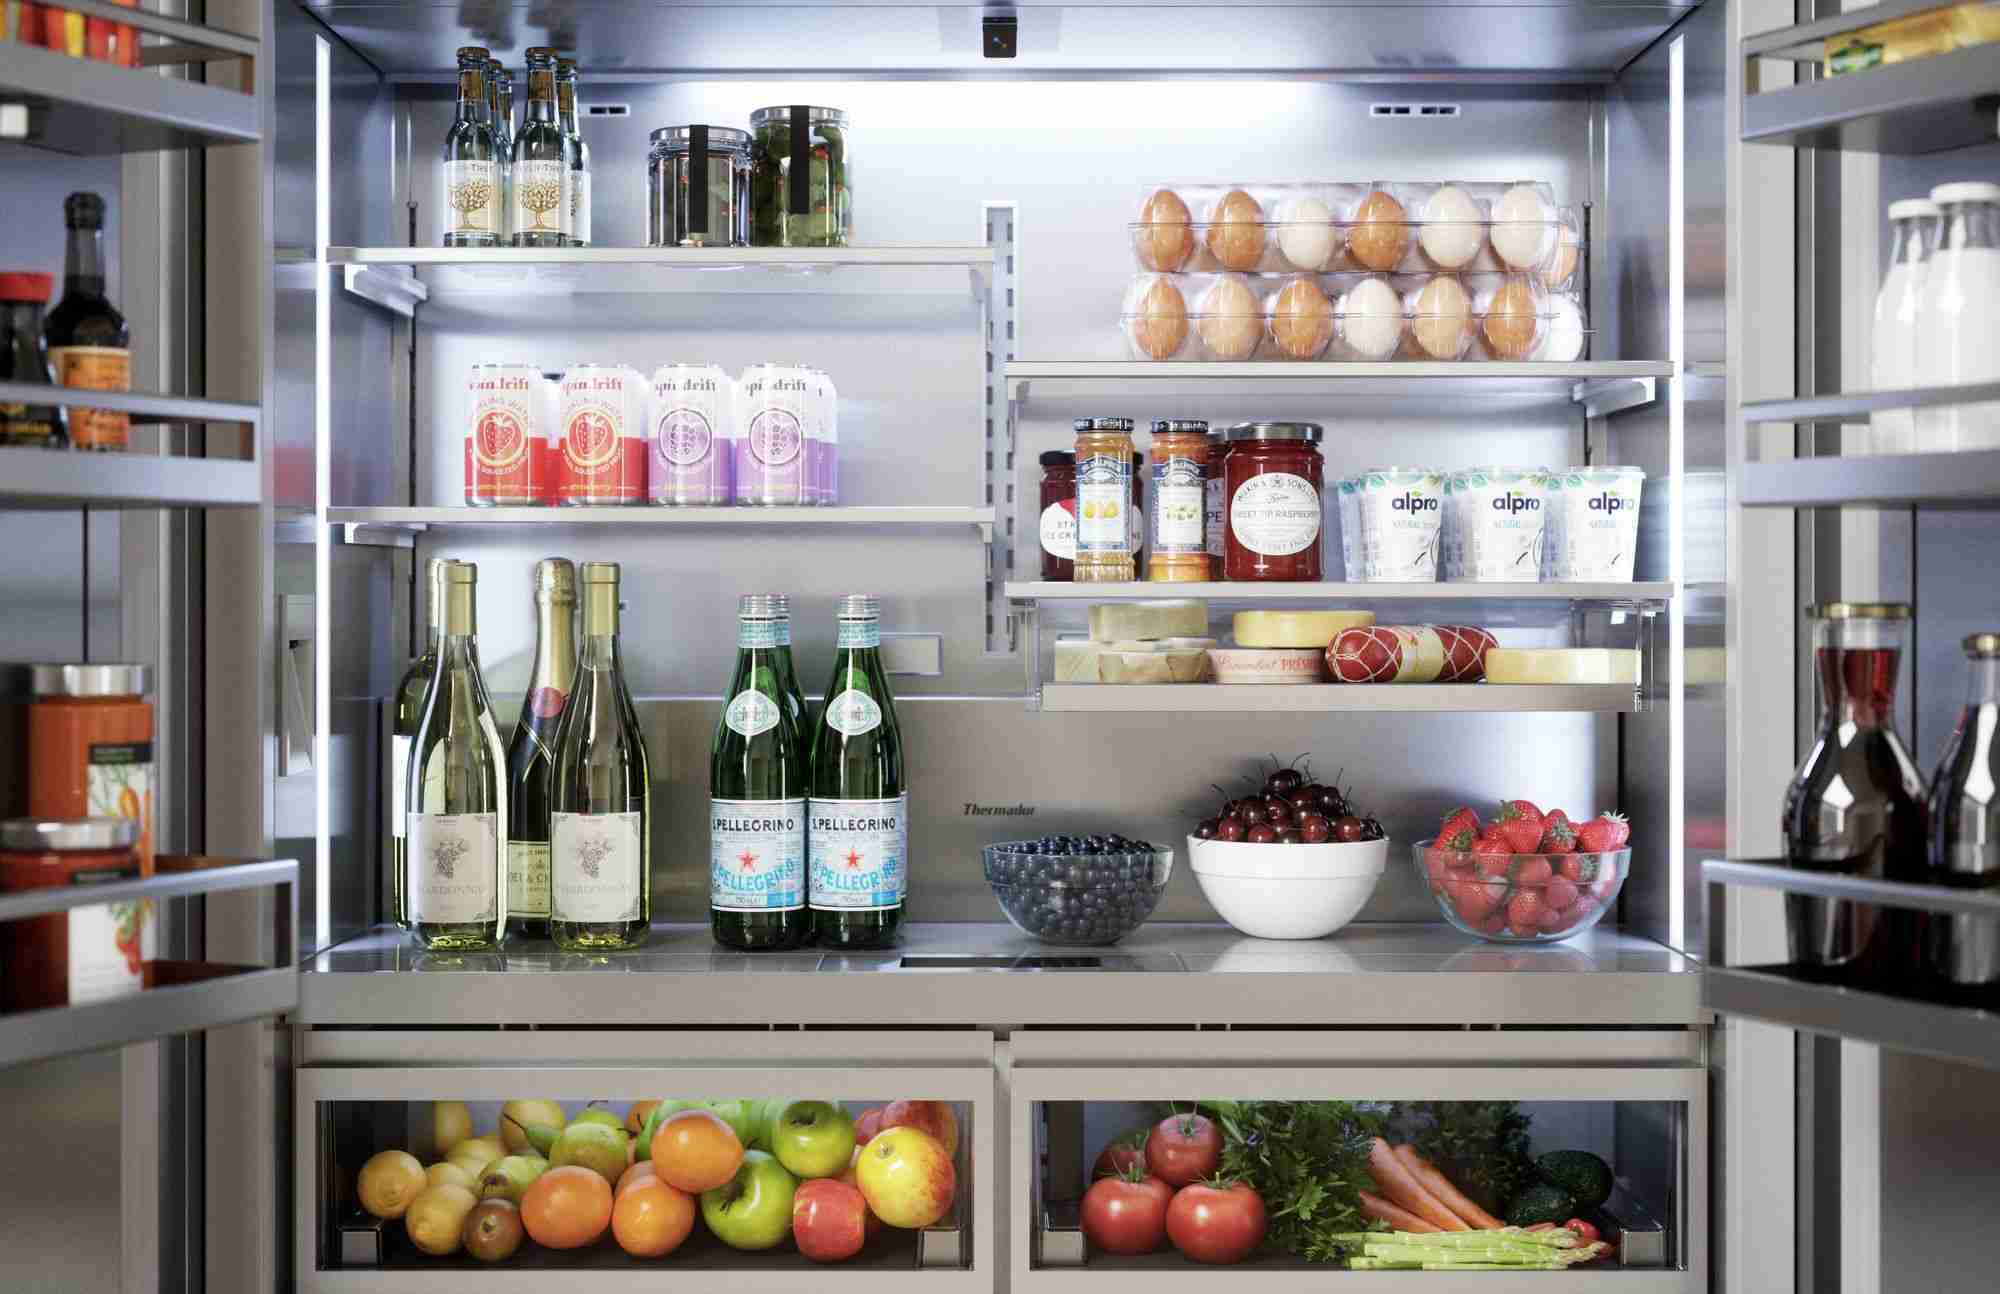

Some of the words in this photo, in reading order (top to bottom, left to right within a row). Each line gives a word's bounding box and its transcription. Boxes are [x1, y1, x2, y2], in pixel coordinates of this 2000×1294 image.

[1392, 491, 1438, 514] alpro
[1493, 491, 1540, 514] alpro
[1588, 491, 1634, 514] alpro
